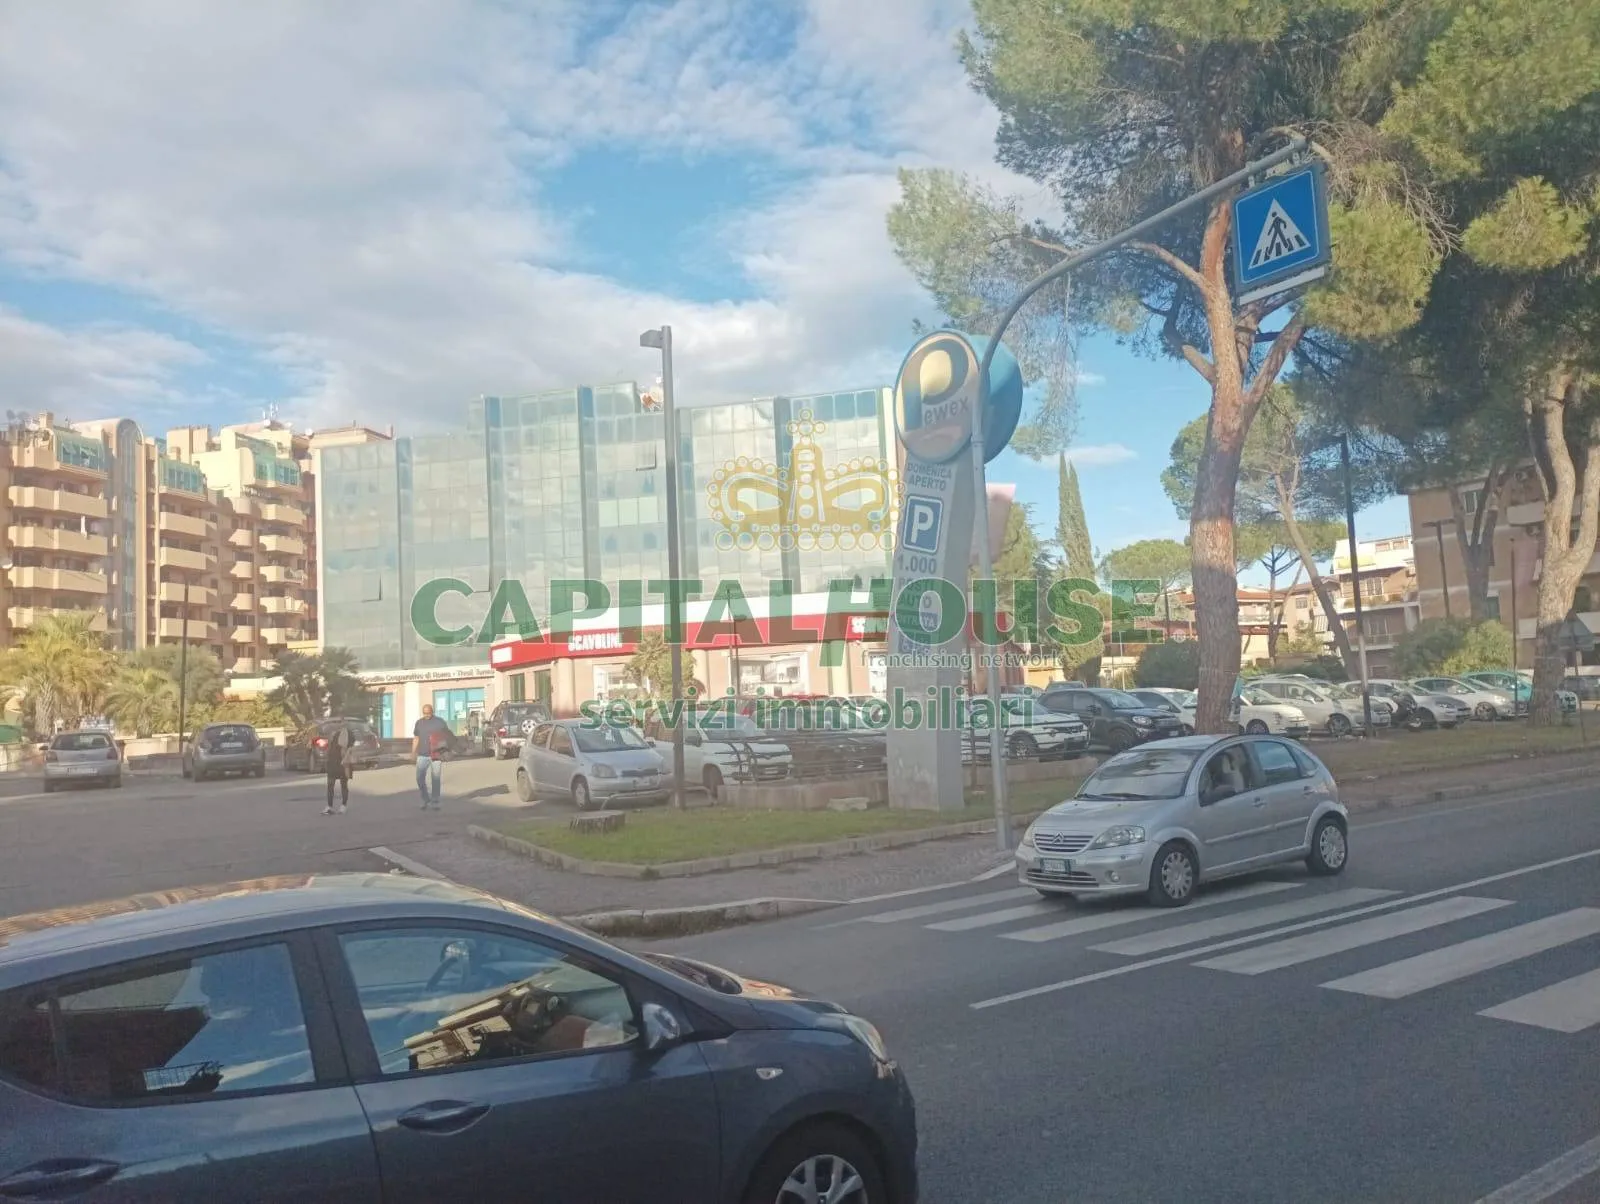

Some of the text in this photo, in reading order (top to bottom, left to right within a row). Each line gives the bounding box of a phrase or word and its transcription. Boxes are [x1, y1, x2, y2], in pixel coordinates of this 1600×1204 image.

[908, 475, 947, 491] APERTO
[911, 504, 934, 544] P
[898, 554, 937, 575] 1.000
